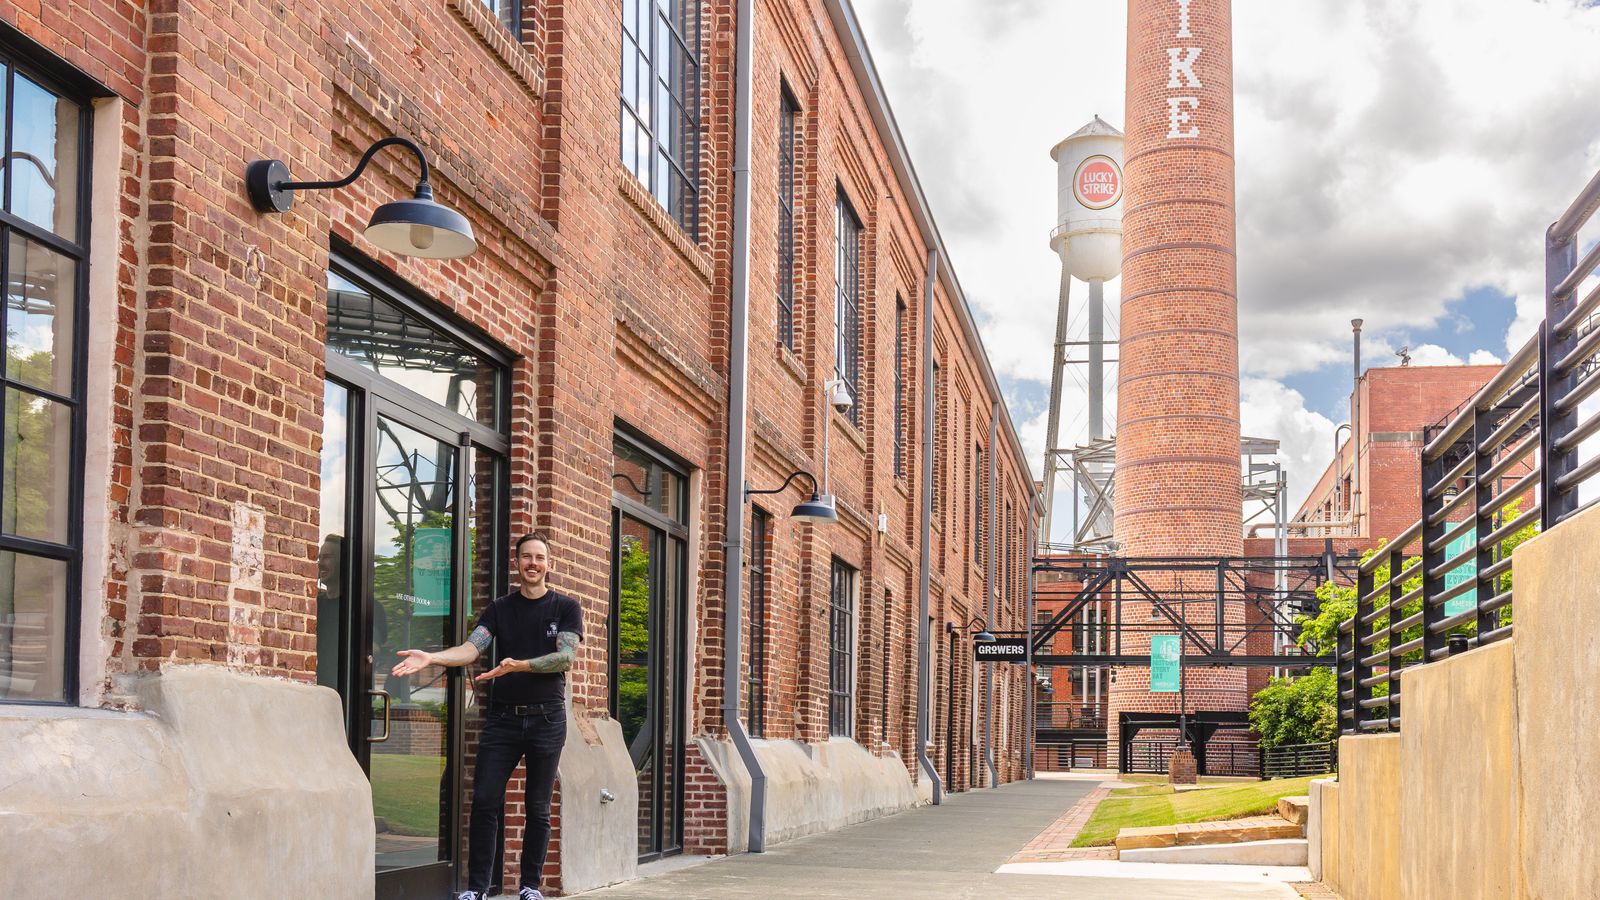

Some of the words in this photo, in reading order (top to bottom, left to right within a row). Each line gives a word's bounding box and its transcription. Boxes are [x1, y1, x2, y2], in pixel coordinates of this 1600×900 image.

[1083, 171, 1114, 183] LUCKY
[1083, 183, 1115, 195] STRIKE
[404, 594, 416, 603] OTHER
[416, 597, 428, 606] DOOR
[978, 645, 1025, 655] GROWERS
